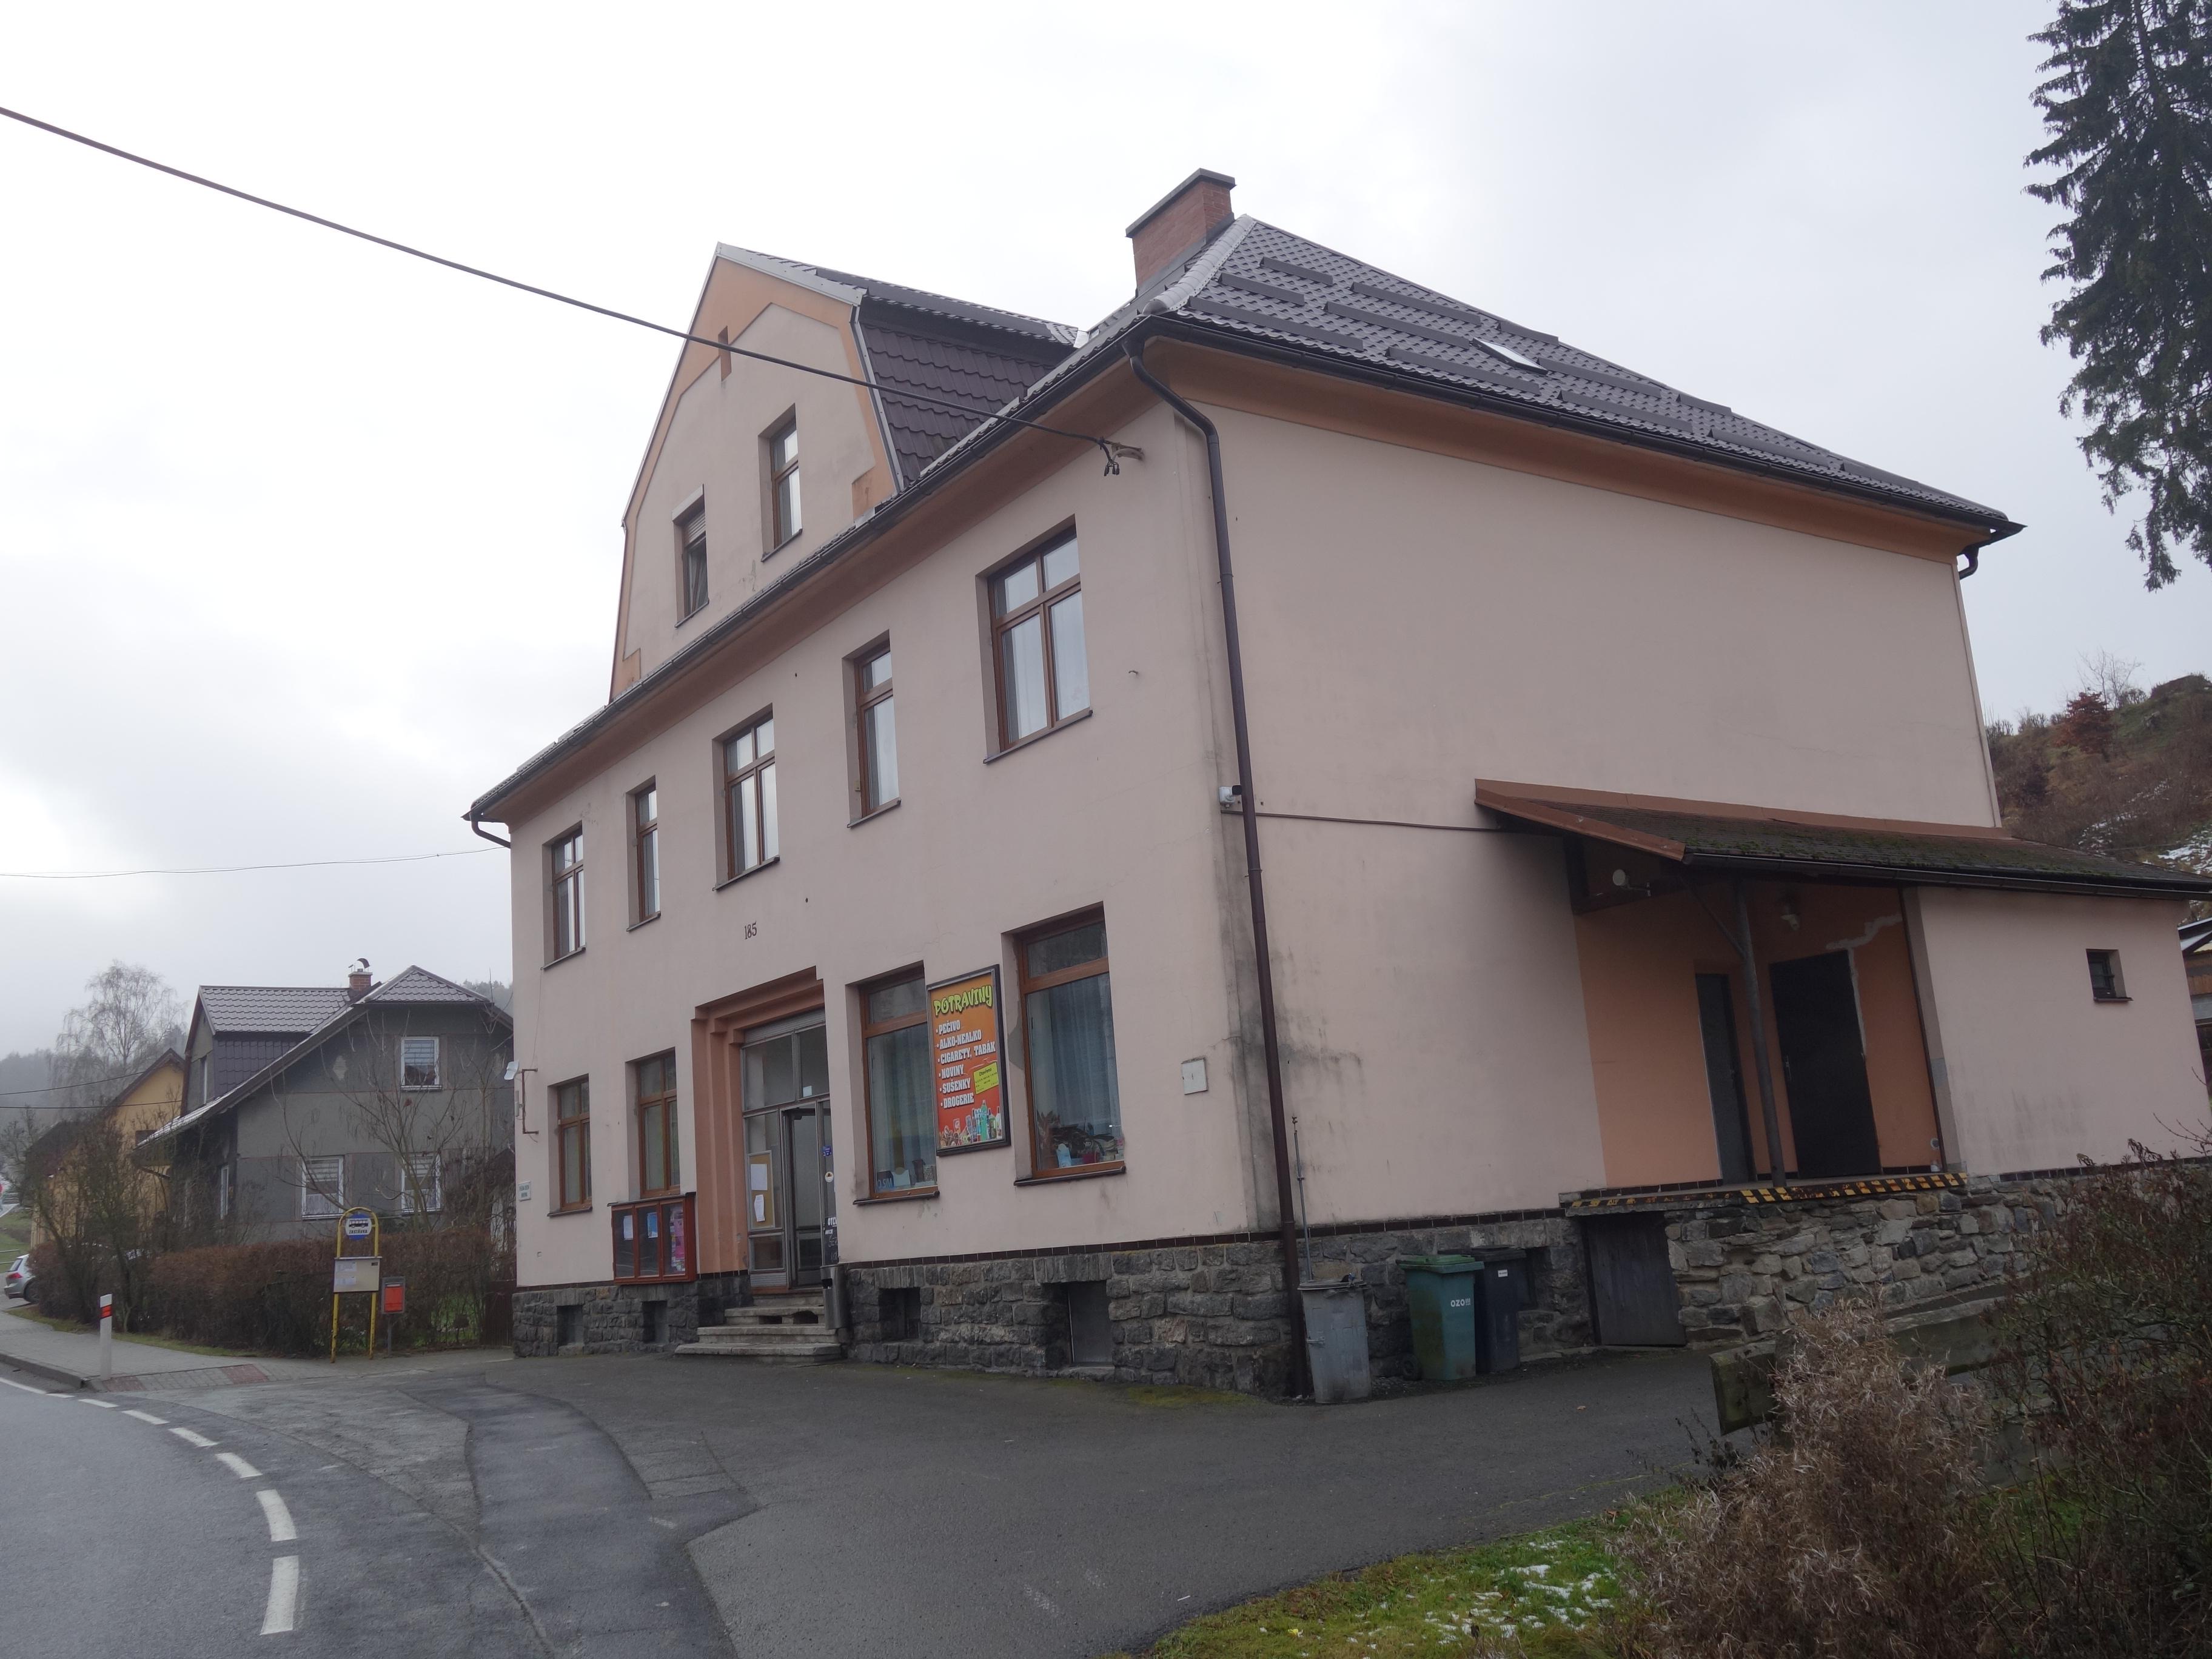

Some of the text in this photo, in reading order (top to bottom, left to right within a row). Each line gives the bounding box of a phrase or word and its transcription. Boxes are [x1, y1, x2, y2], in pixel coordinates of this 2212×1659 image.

[745, 920, 757, 939] 185
[934, 985, 993, 1016] POTRAVINY
[939, 1020, 960, 1034] PEČIVO
[940, 1030, 982, 1049] ALKO-NEALKO
[941, 1040, 996, 1065] CIGARETY, TABÁK
[941, 1064, 964, 1079] NOVINY
[942, 1078, 971, 1094] SUŠENKY
[943, 1092, 974, 1109] DROGERIE
[1450, 1298, 1471, 1307] OZO!!!
